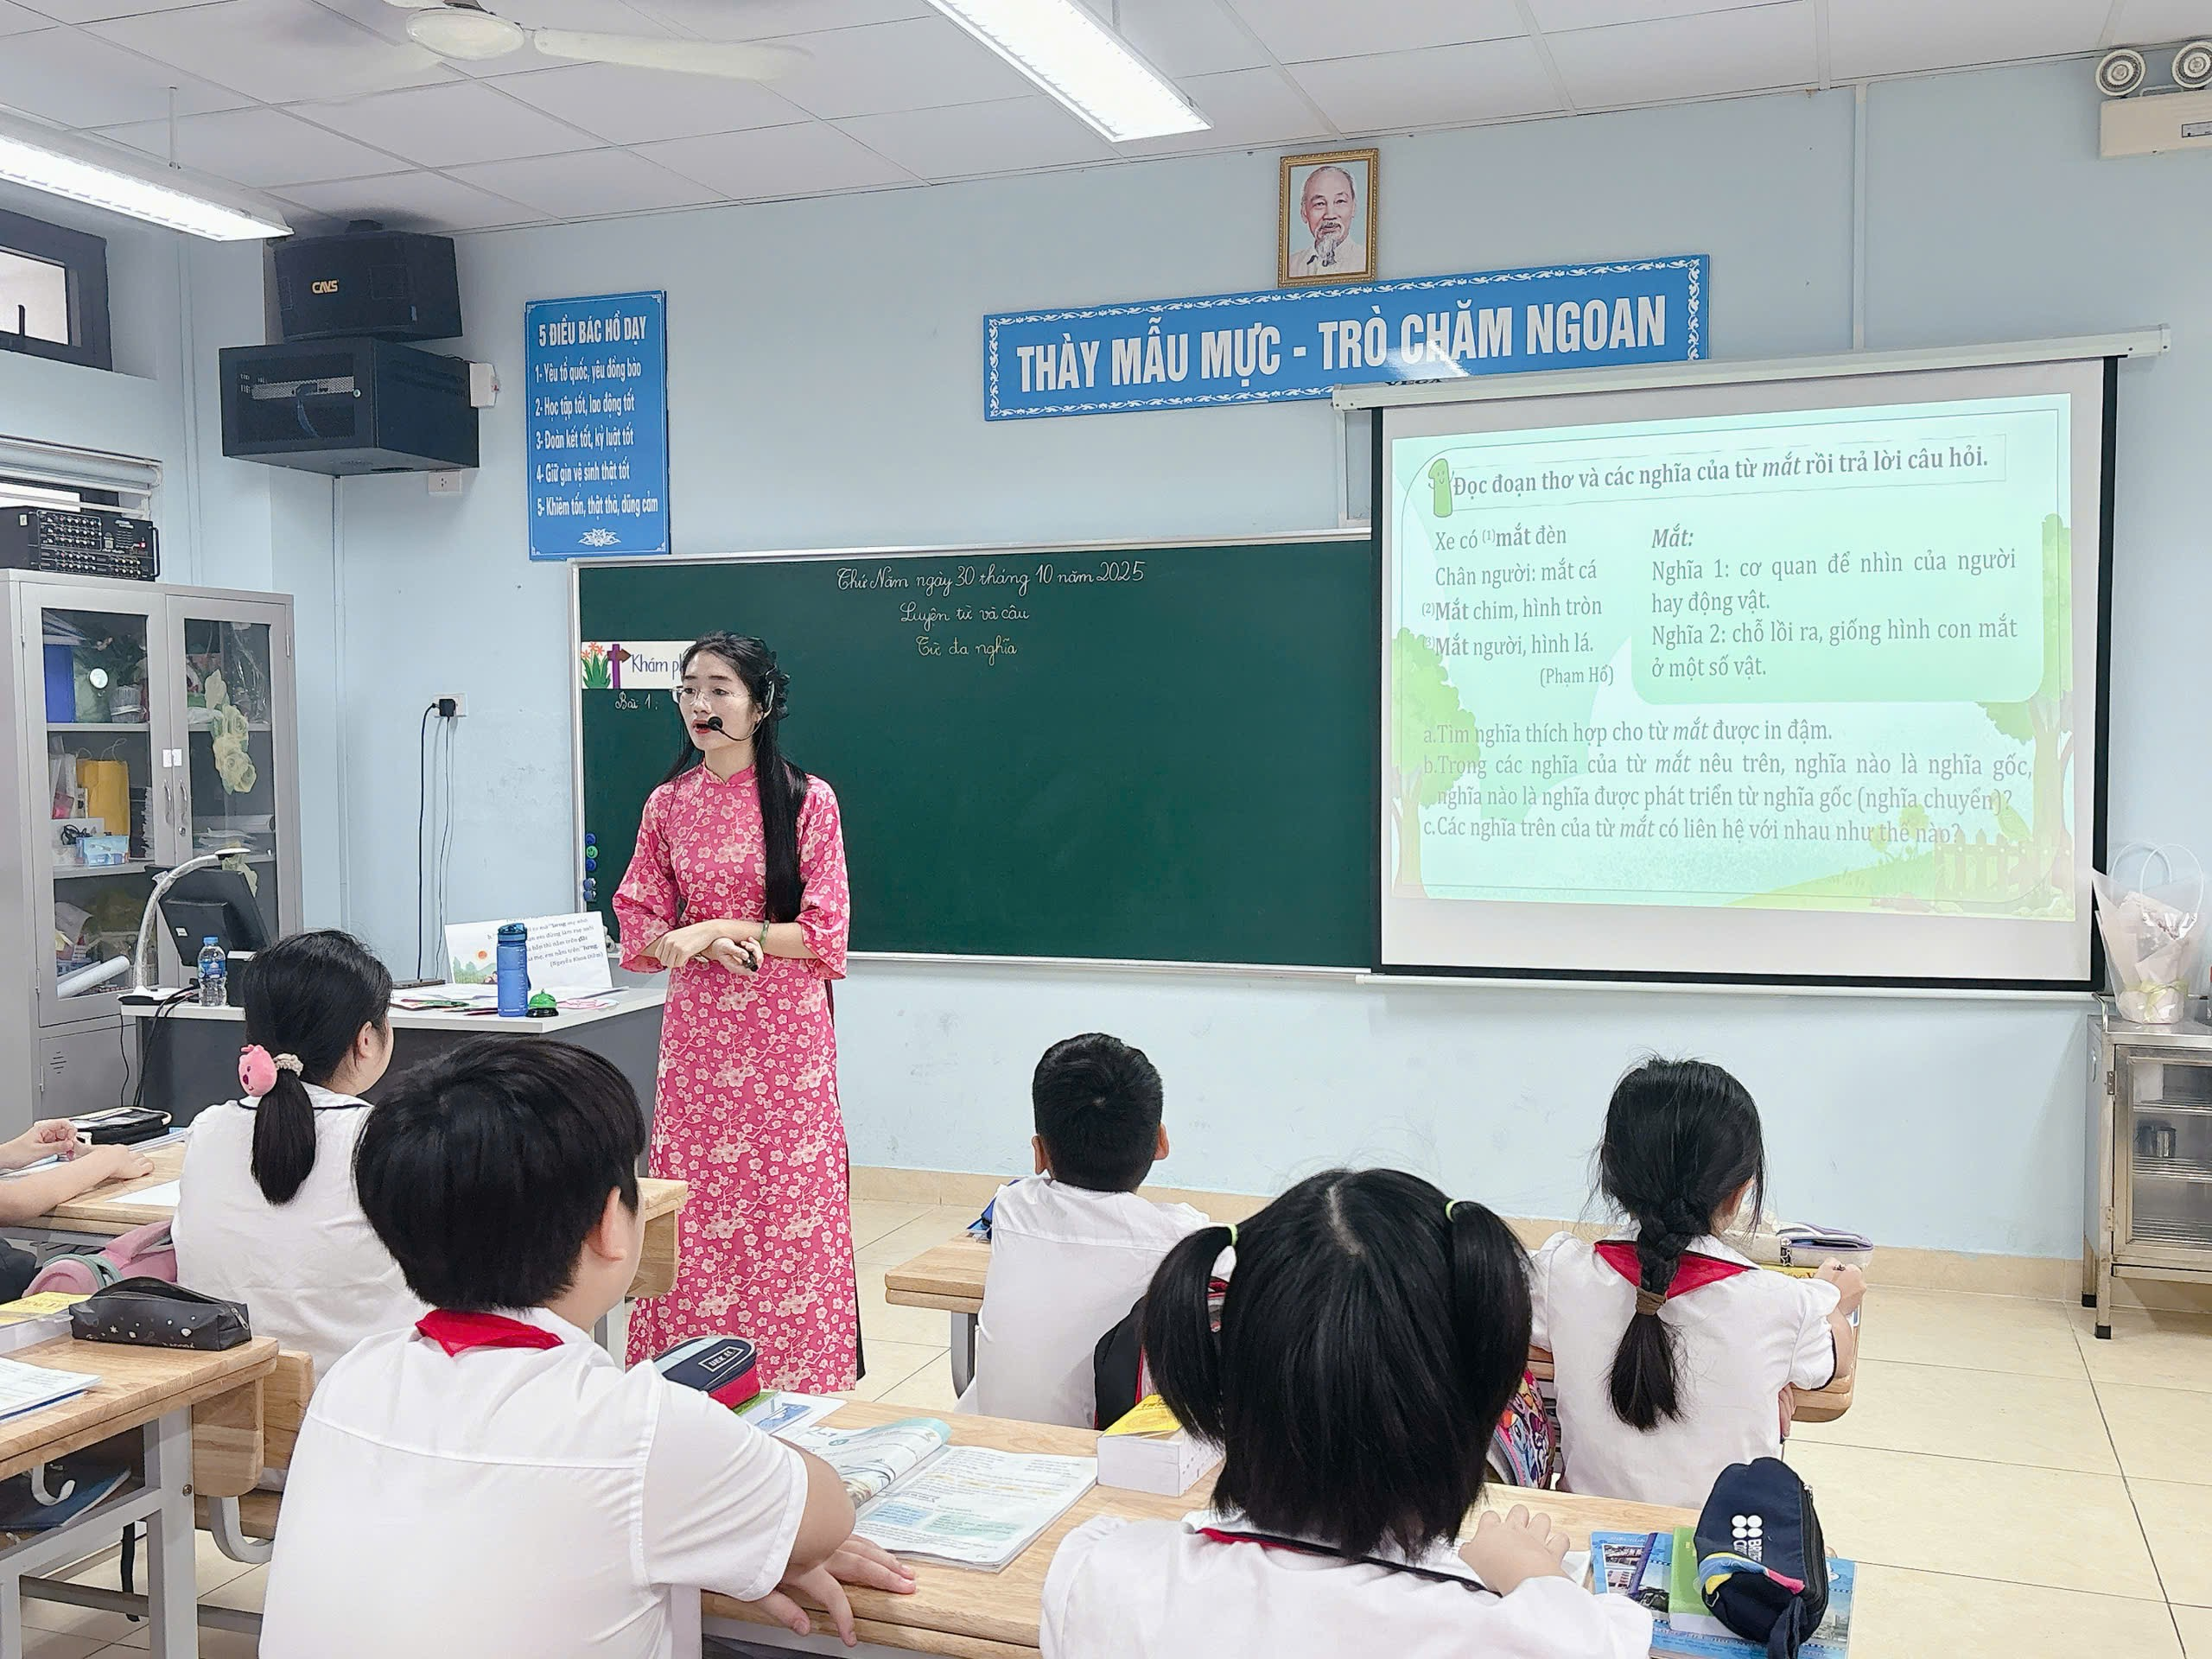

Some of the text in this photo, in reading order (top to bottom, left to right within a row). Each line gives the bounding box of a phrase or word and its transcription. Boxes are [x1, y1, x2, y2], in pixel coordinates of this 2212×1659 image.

[539, 310, 646, 346] 5 ĐIỀU BÁC HỒ DẠY
[1112, 316, 1188, 386] MẪU
[1201, 322, 1280, 387] MỰC
[1318, 304, 1388, 371] TRÒ
[1400, 299, 1512, 365] CHĂM
[1526, 295, 1666, 354] NGOAN
[543, 363, 557, 383] Yêu
[560, 356, 568, 381] tổ
[569, 357, 590, 385] quốc,
[592, 360, 605, 384] yêu
[607, 355, 626, 382] đồng
[627, 357, 640, 377] bào
[544, 397, 558, 421] Học
[561, 396, 572, 421] tập
[575, 391, 588, 415] tốt,
[590, 394, 601, 413] lao
[603, 391, 621, 418] động
[624, 388, 634, 411] tốt
[544, 429, 563, 448] Đoàn
[566, 424, 578, 448] kết
[580, 424, 593, 449] tốt,
[595, 424, 604, 451] kỷ
[607, 427, 620, 452] luật
[623, 422, 633, 445] tốt
[546, 463, 558, 482] Giữ
[560, 463, 571, 486] gìn
[574, 462, 582, 487] vệ
[584, 461, 599, 481] sinh
[601, 461, 617, 486] thật
[619, 456, 630, 480] tốt
[1453, 445, 1988, 499] Đọc đoạn thơ và các nghĩa của từ mắt rồi trả lời câu hỏi.
[546, 496, 569, 516] Khiêm
[588, 495, 603, 520] thật
[622, 494, 640, 518] dũng
[642, 490, 658, 512] cảm
[1435, 531, 1455, 550] Xe
[1459, 530, 1478, 550] có
[1535, 525, 1567, 545] đèn
[1652, 524, 1694, 549] Mắt:
[837, 561, 1145, 596] Thứ Năm ngày 30 tháng 10 năm 2025
[1436, 557, 1597, 588] Chân người: mắt cá
[1652, 548, 2016, 585] Nghĩa 1: cơ quan để nhìn của người
[956, 605, 972, 620] từ
[980, 606, 997, 620] và
[1001, 606, 1029, 620] câu
[1473, 600, 1518, 621] chim,
[1523, 597, 1560, 617] hình
[1566, 595, 1602, 615] tròn
[1652, 588, 1770, 618] hay động vật.
[1473, 635, 1526, 661] người,
[1531, 633, 1570, 654] hình
[1574, 632, 1593, 652] lá.
[1652, 613, 2018, 650] Nghĩa 2: chỗ lồi ra, giống hình con mắt
[632, 654, 667, 672] Khám
[949, 638, 969, 655] đa
[976, 636, 1017, 665] nghĩa
[1540, 667, 1584, 688] (Phạm
[1652, 654, 1766, 680] ở một số vật.
[1475, 724, 1520, 747] nghĩa
[1525, 723, 1567, 742] thích
[1573, 722, 1607, 747] hợp
[1612, 721, 1643, 741] cho
[1649, 721, 1669, 741] từ
[1673, 717, 1708, 741] mắt
[1713, 719, 1759, 744] được
[1764, 719, 1782, 740] in
[1788, 719, 1832, 743] đậm.
[1496, 754, 1522, 773] các
[1532, 754, 1578, 779] nghĩa
[1587, 753, 1616, 773] của
[1626, 753, 1647, 772] từ
[1656, 749, 1691, 772] mắt
[1700, 753, 1732, 772] nêu
[1743, 753, 1785, 776] trên,
[1795, 753, 1846, 779] nghĩa
[1857, 753, 1891, 773] nào
[1901, 753, 1917, 774] là
[1929, 753, 1982, 779] nghĩa
[1993, 753, 2032, 781] gốc,
